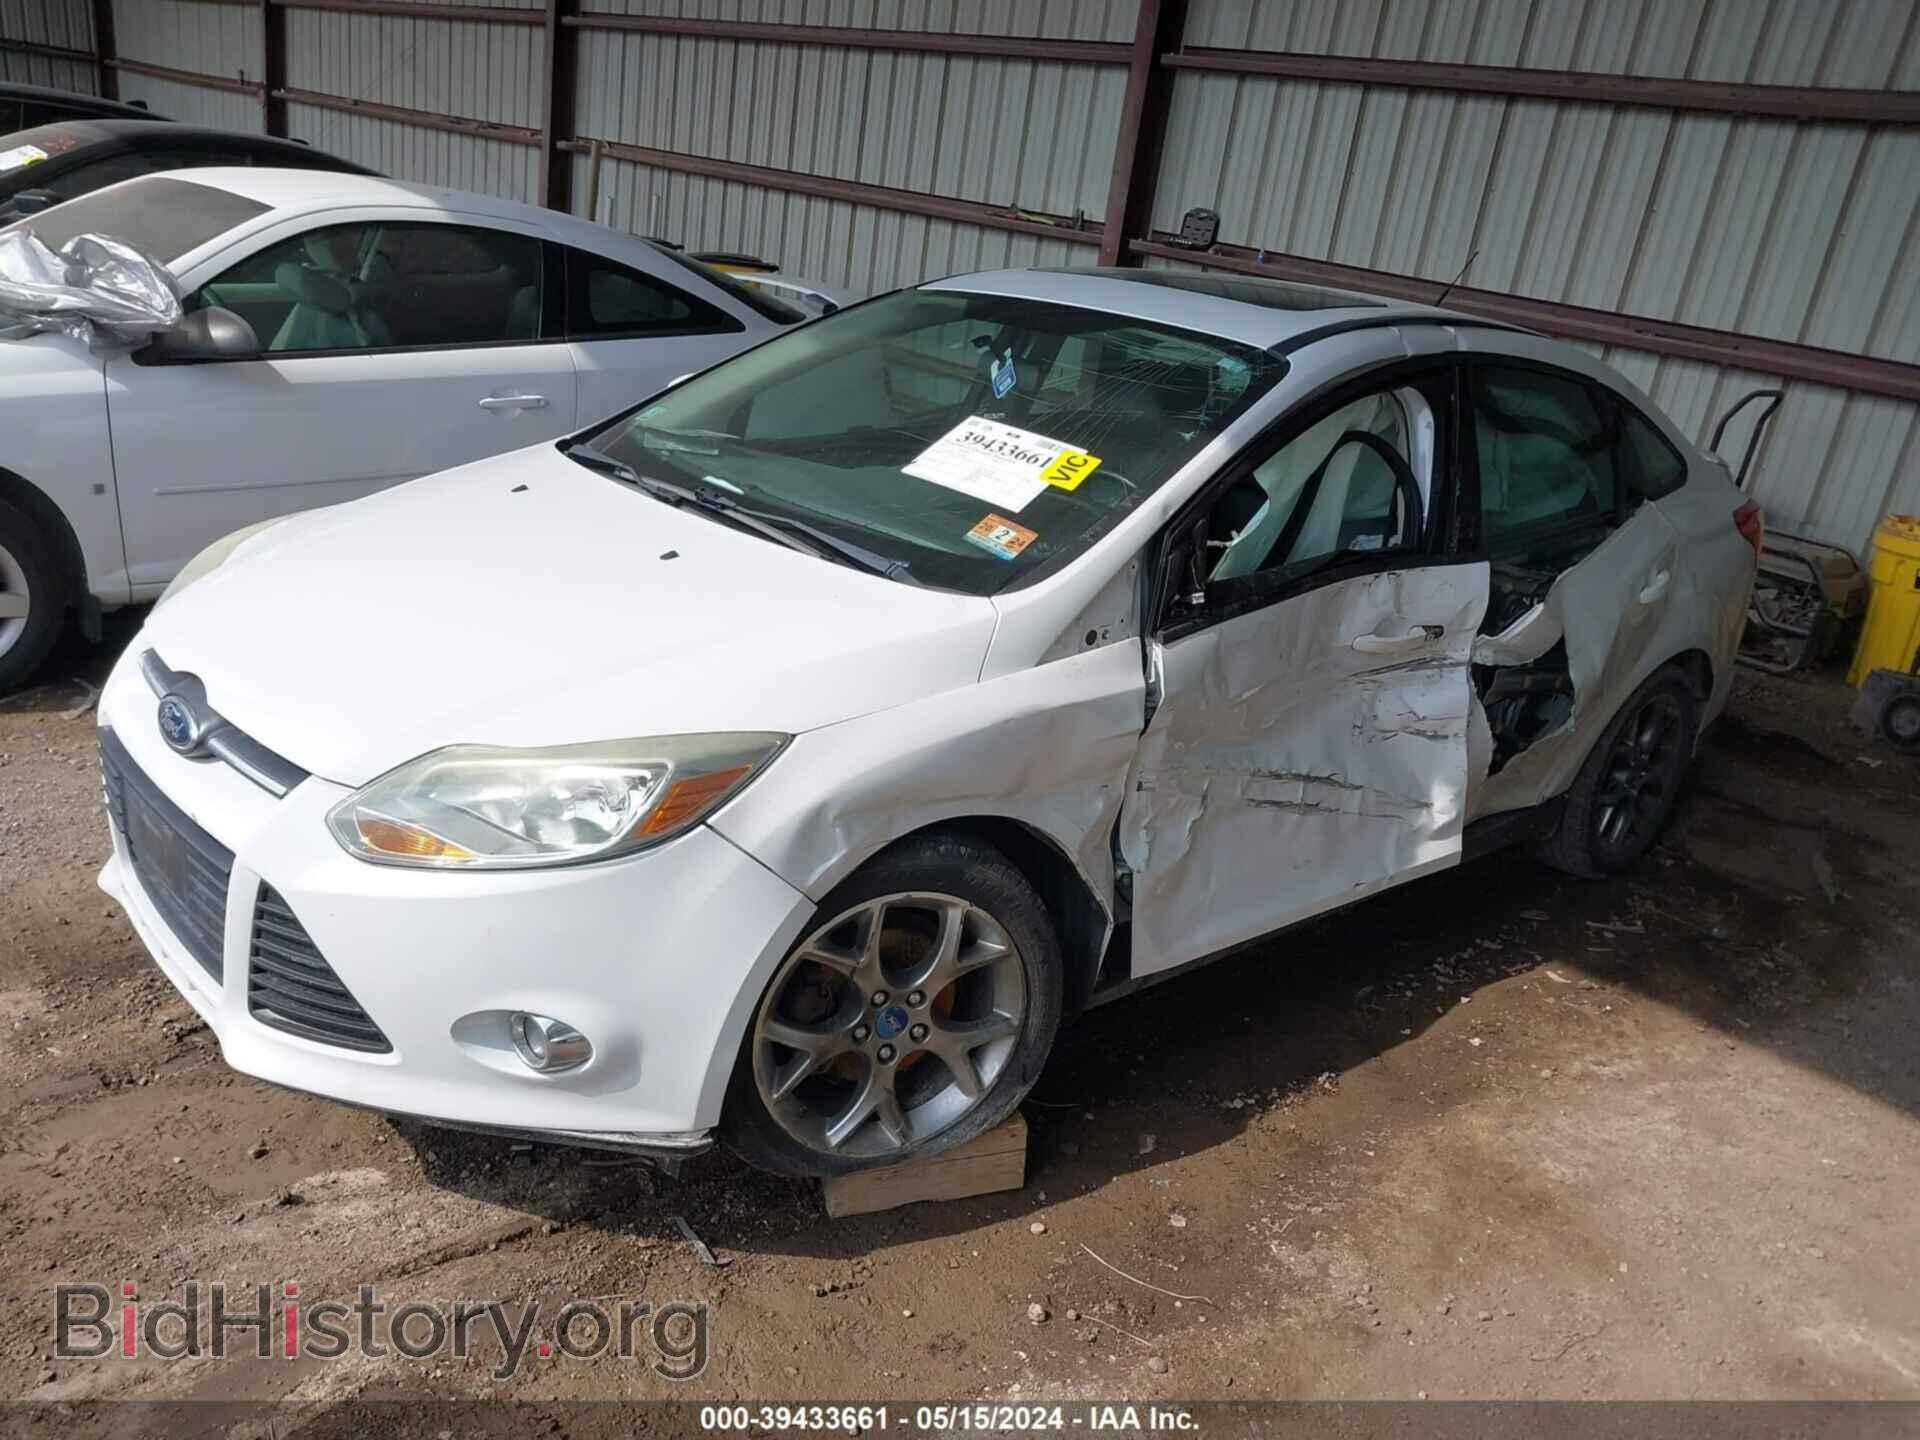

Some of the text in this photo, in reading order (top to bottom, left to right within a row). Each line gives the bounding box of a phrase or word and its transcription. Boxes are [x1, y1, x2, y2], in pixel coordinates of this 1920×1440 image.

[955, 430, 1054, 468] 39433661
[1047, 455, 1089, 484] VIC
[995, 529, 1010, 540] 2
